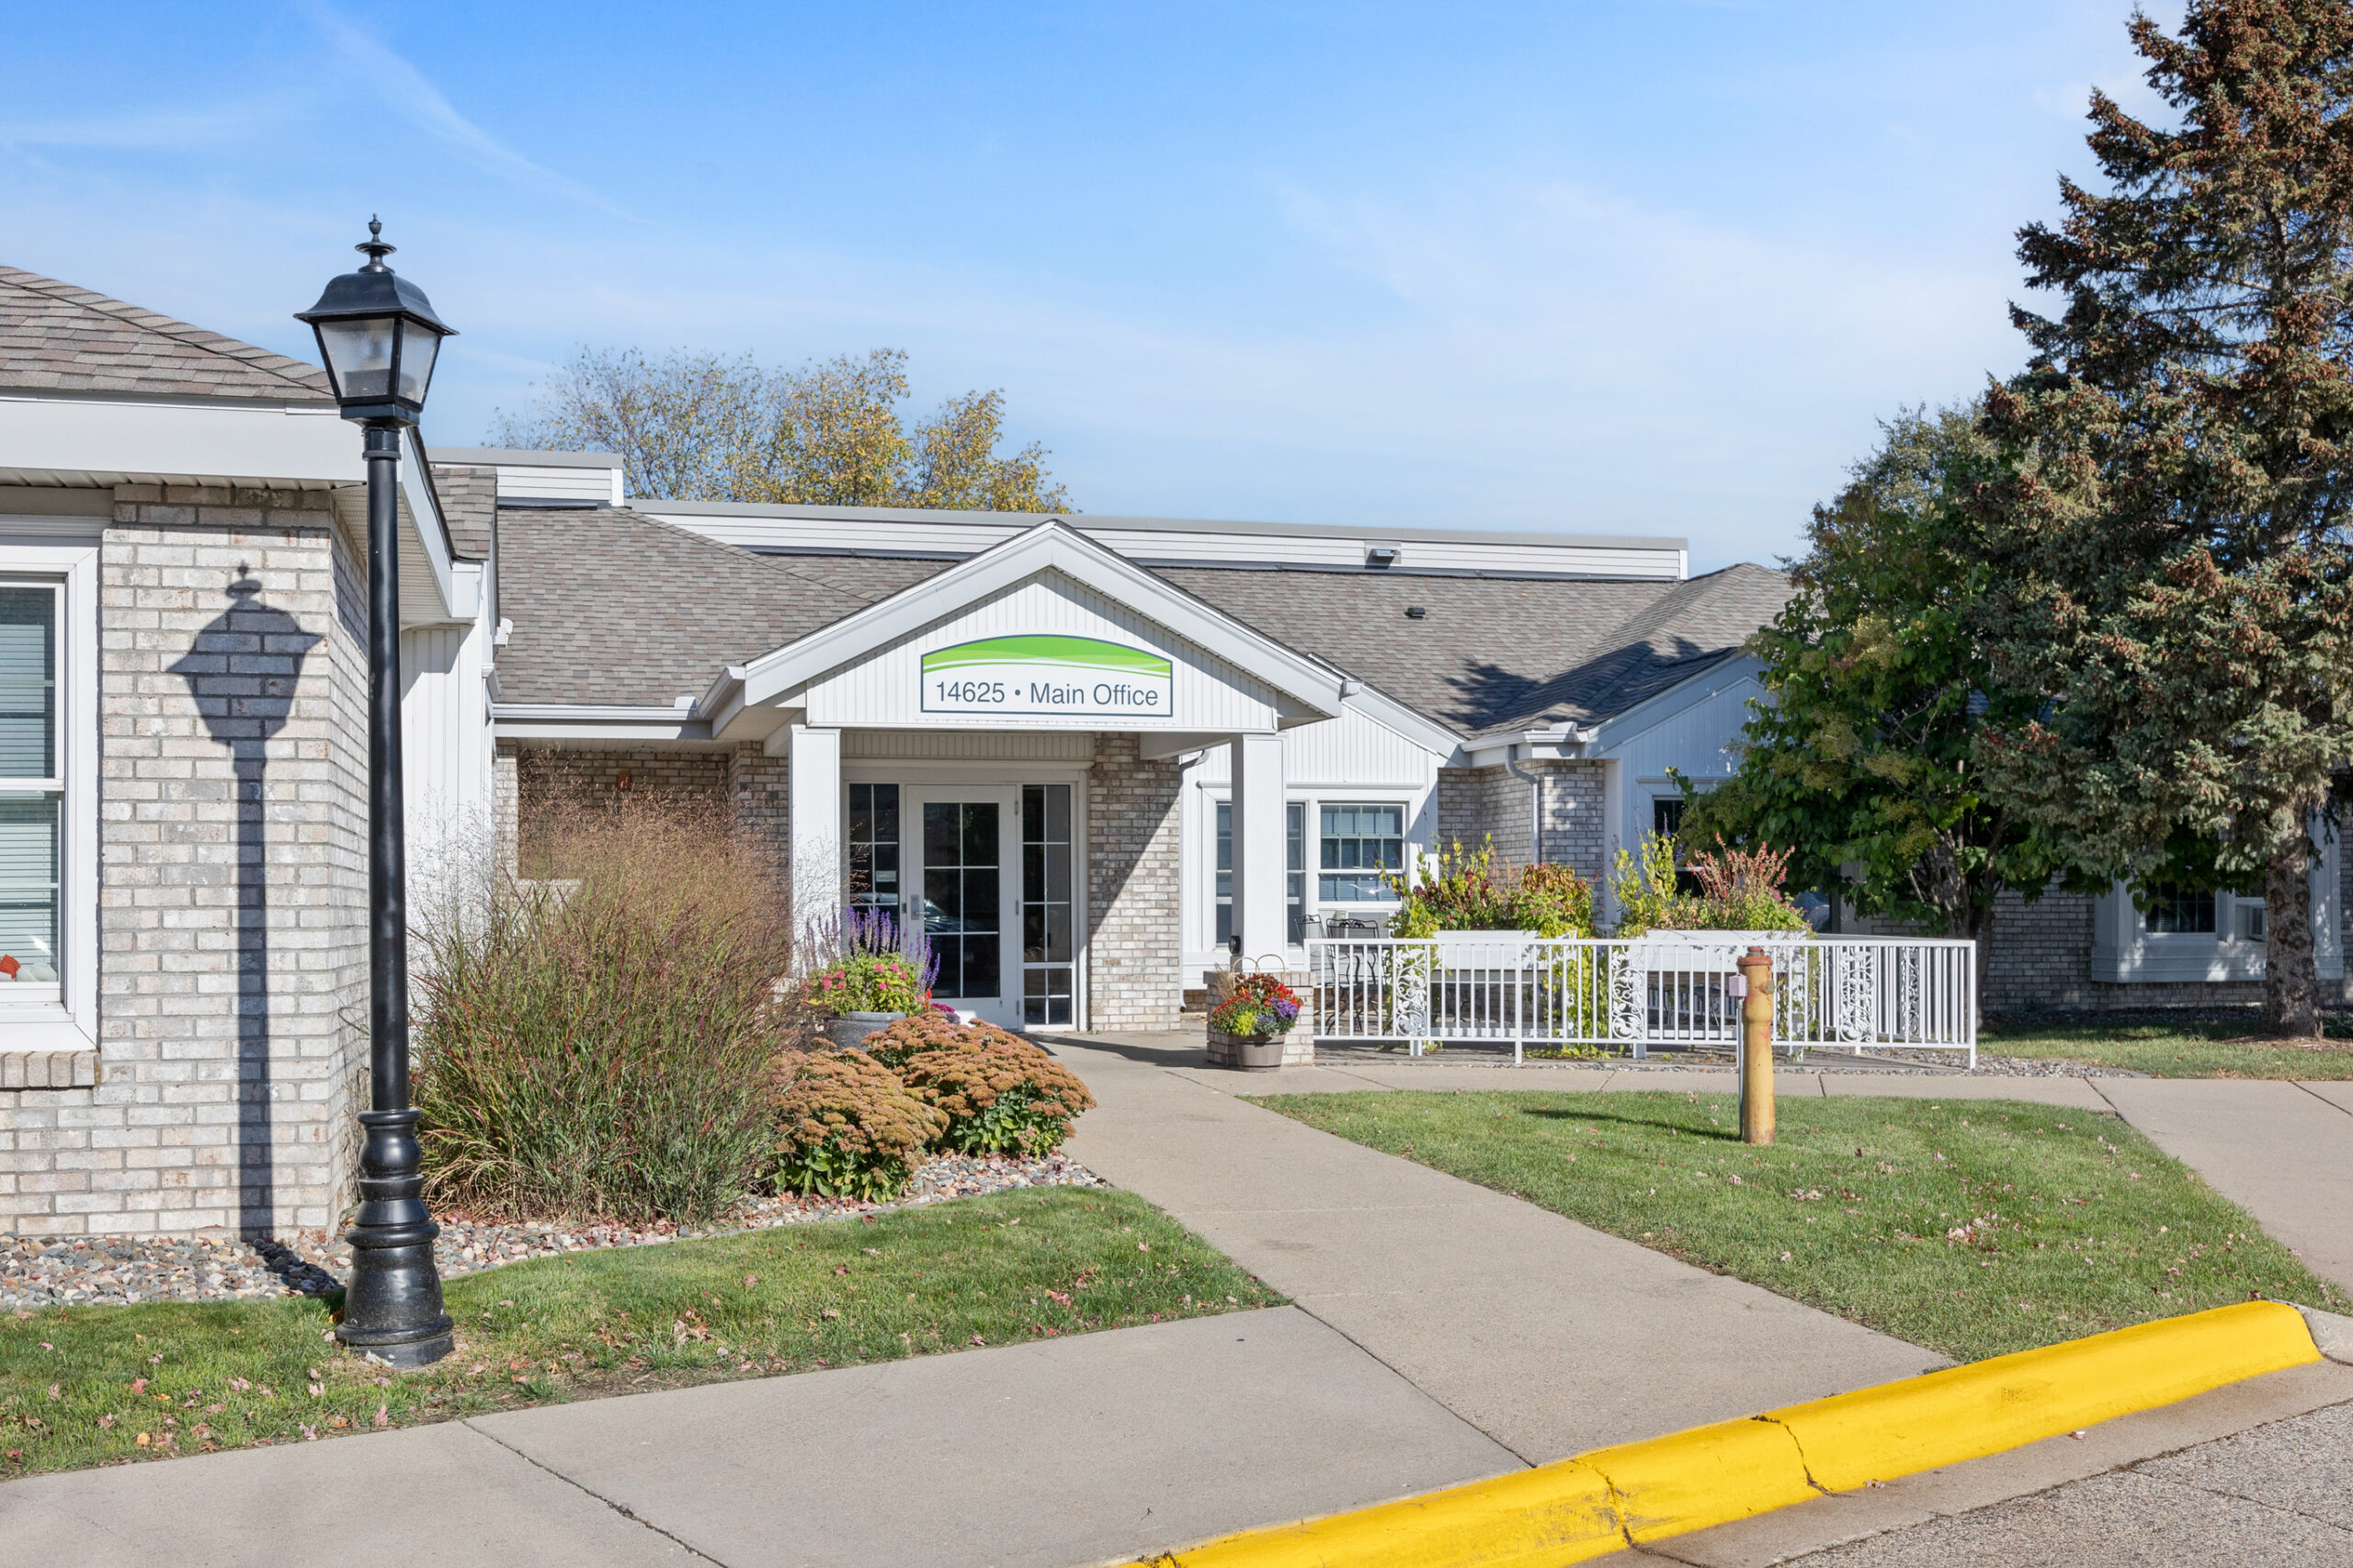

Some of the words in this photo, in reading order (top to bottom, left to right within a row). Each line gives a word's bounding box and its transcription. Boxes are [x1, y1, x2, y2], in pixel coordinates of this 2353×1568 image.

[936, 681, 1006, 704] 14625
[1030, 682, 1085, 705] Main
[1093, 683, 1158, 707] Office
